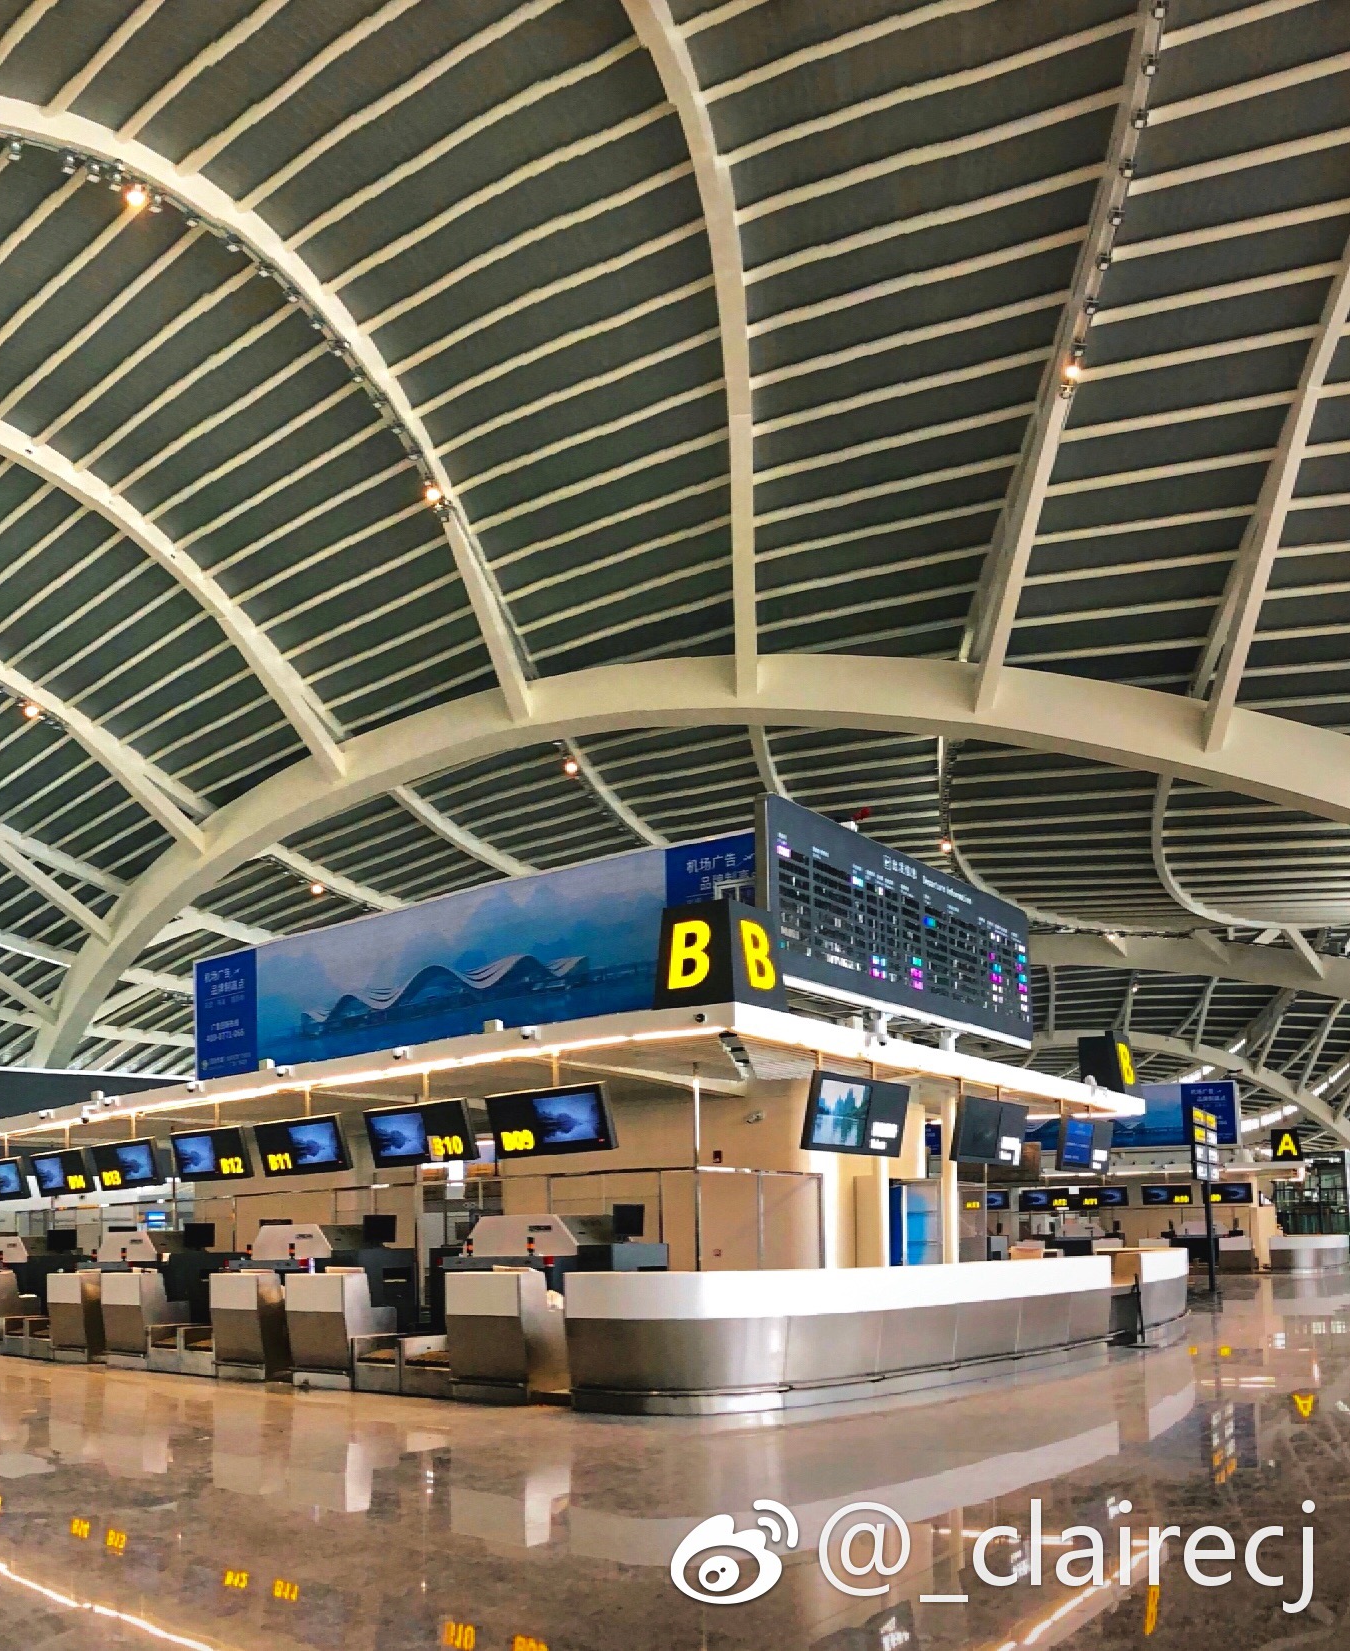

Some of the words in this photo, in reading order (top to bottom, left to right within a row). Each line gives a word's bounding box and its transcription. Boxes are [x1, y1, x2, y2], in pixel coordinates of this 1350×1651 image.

[686, 852, 737, 874] 机场广告
[667, 919, 711, 990] B
[739, 918, 776, 990] B
[430, 1134, 465, 1159] B10
[500, 1127, 536, 1153] B09
[1276, 1132, 1298, 1156] A
[220, 1157, 244, 1176] B12
[266, 1153, 293, 1172] B11
